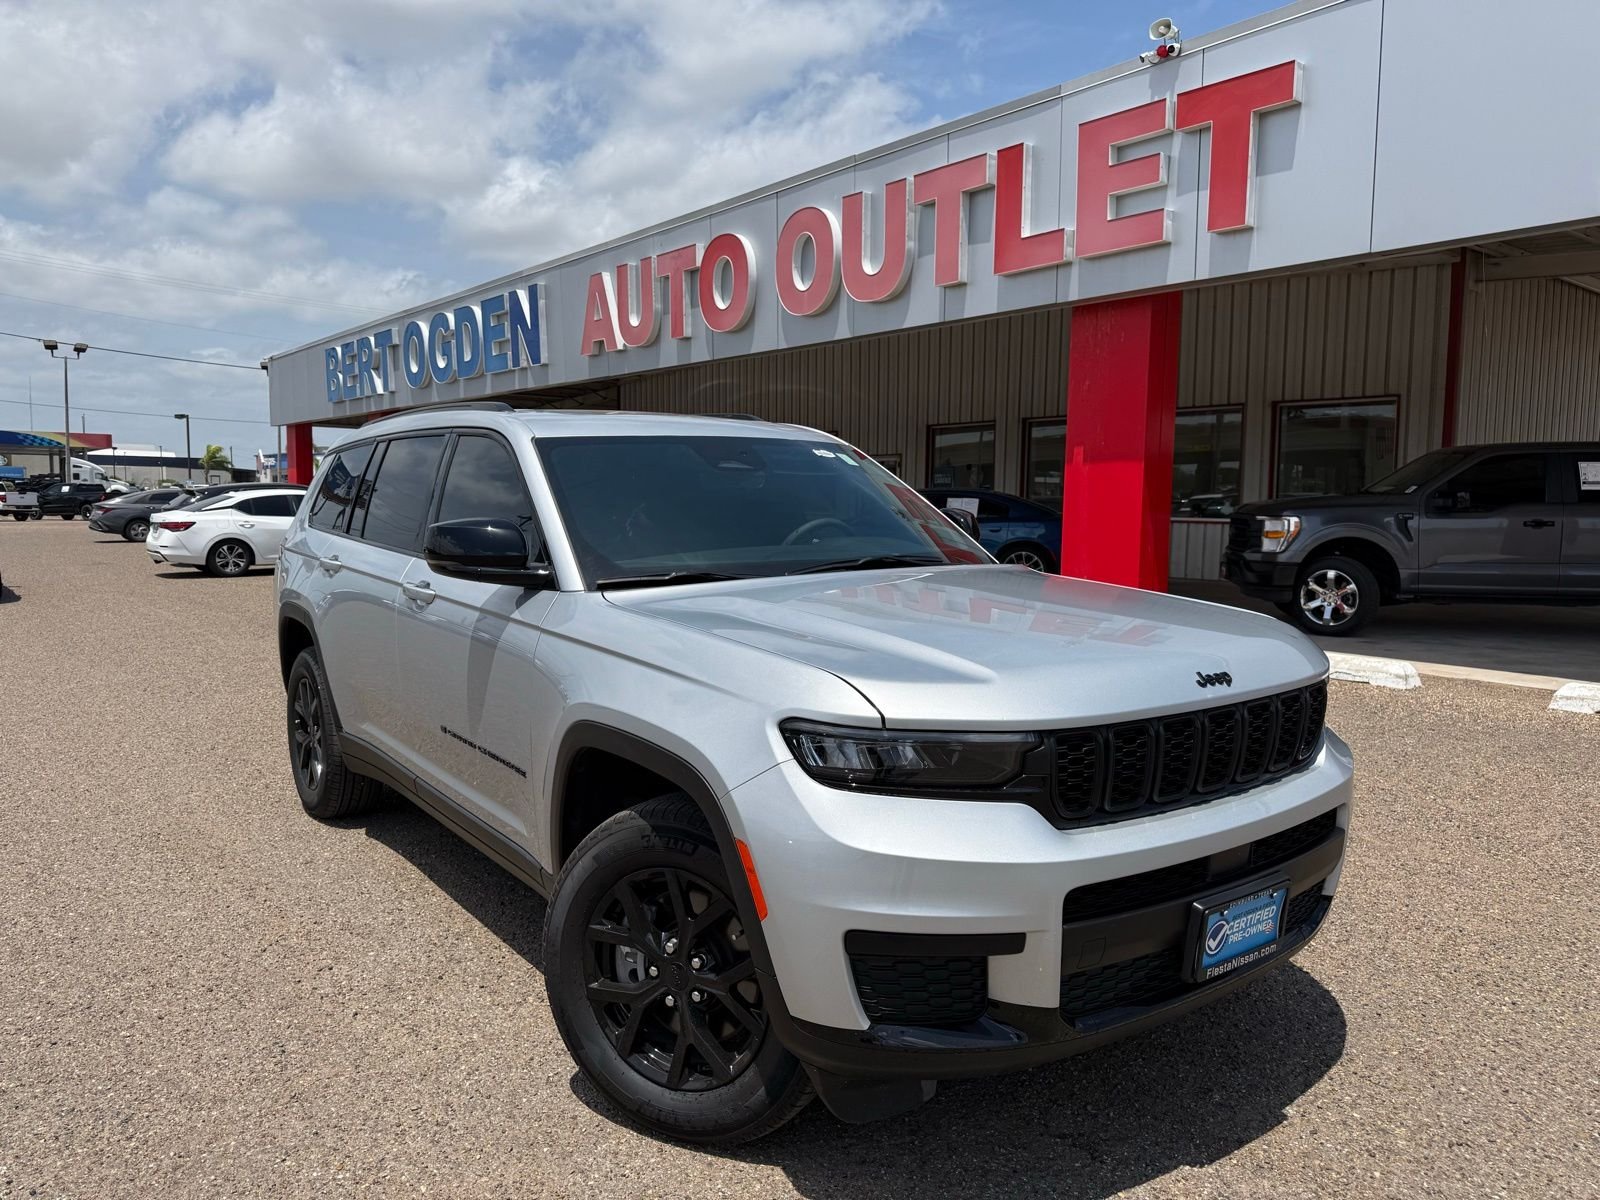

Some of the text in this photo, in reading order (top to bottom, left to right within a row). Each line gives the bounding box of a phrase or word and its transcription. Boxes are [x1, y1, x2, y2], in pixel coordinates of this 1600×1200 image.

[325, 59, 1302, 402] BERT OGDEN AUTO OUTLET
[1195, 671, 1233, 689] Jeep
[1227, 906, 1277, 934] CERTIFIED
[1228, 920, 1273, 944] PRE-OWNED
[1206, 944, 1277, 979] FiestaNissan.com
